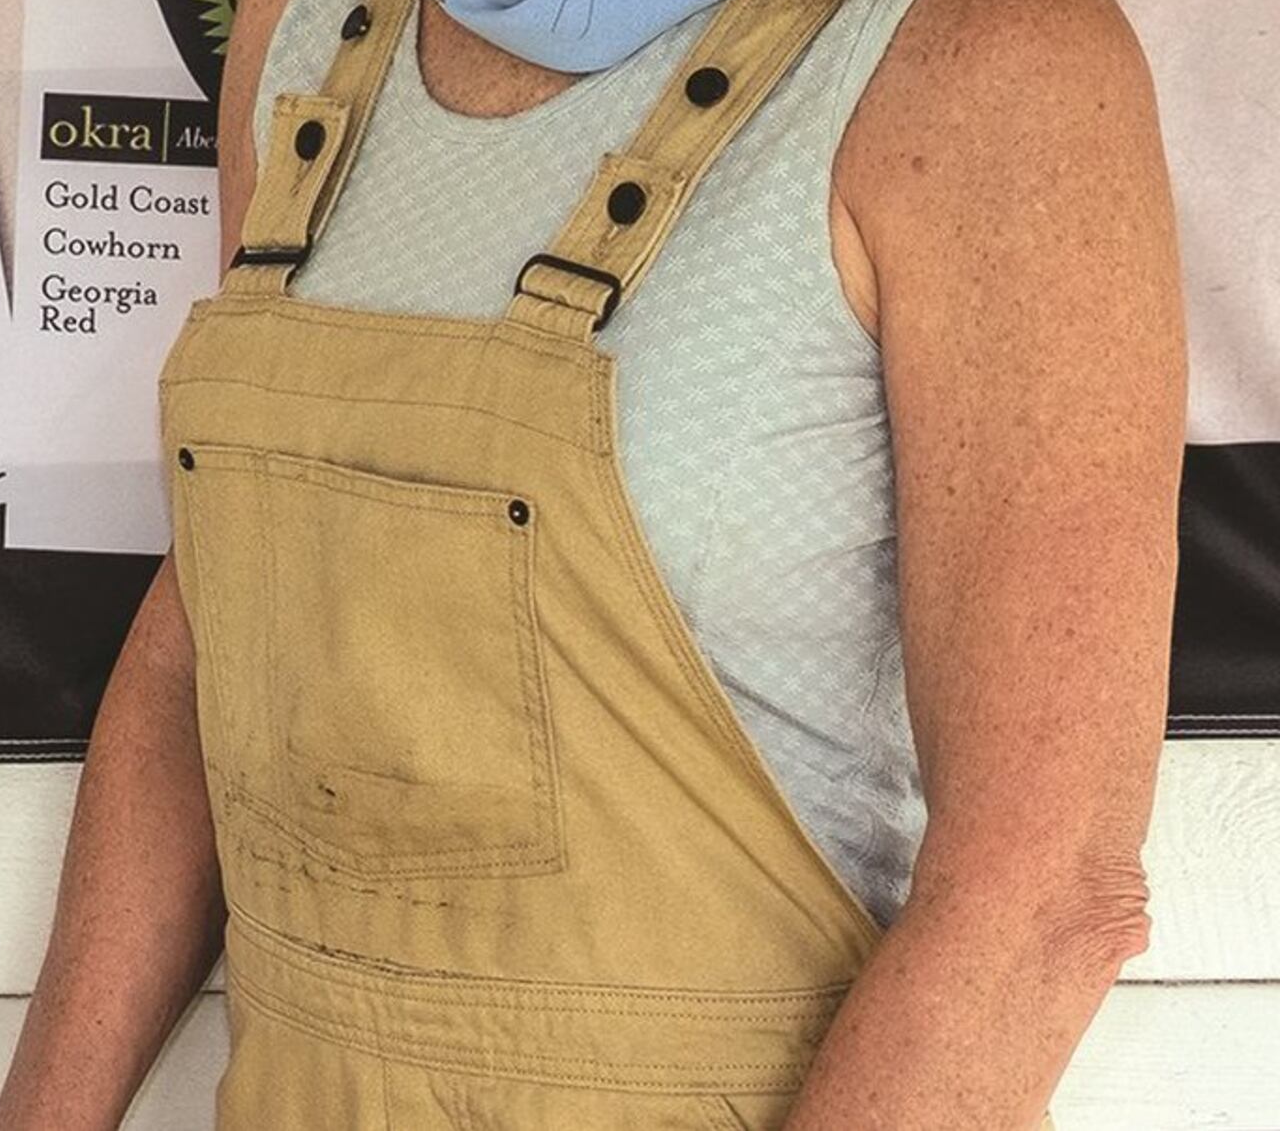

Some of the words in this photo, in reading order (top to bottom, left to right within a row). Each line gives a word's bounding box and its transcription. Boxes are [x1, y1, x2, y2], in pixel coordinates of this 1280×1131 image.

[49, 105, 152, 151] okra
[45, 181, 119, 211] Gold
[129, 185, 210, 215] Coast
[43, 228, 181, 260] Cowhorn
[41, 274, 158, 314] Georgia
[40, 306, 97, 334] Red
